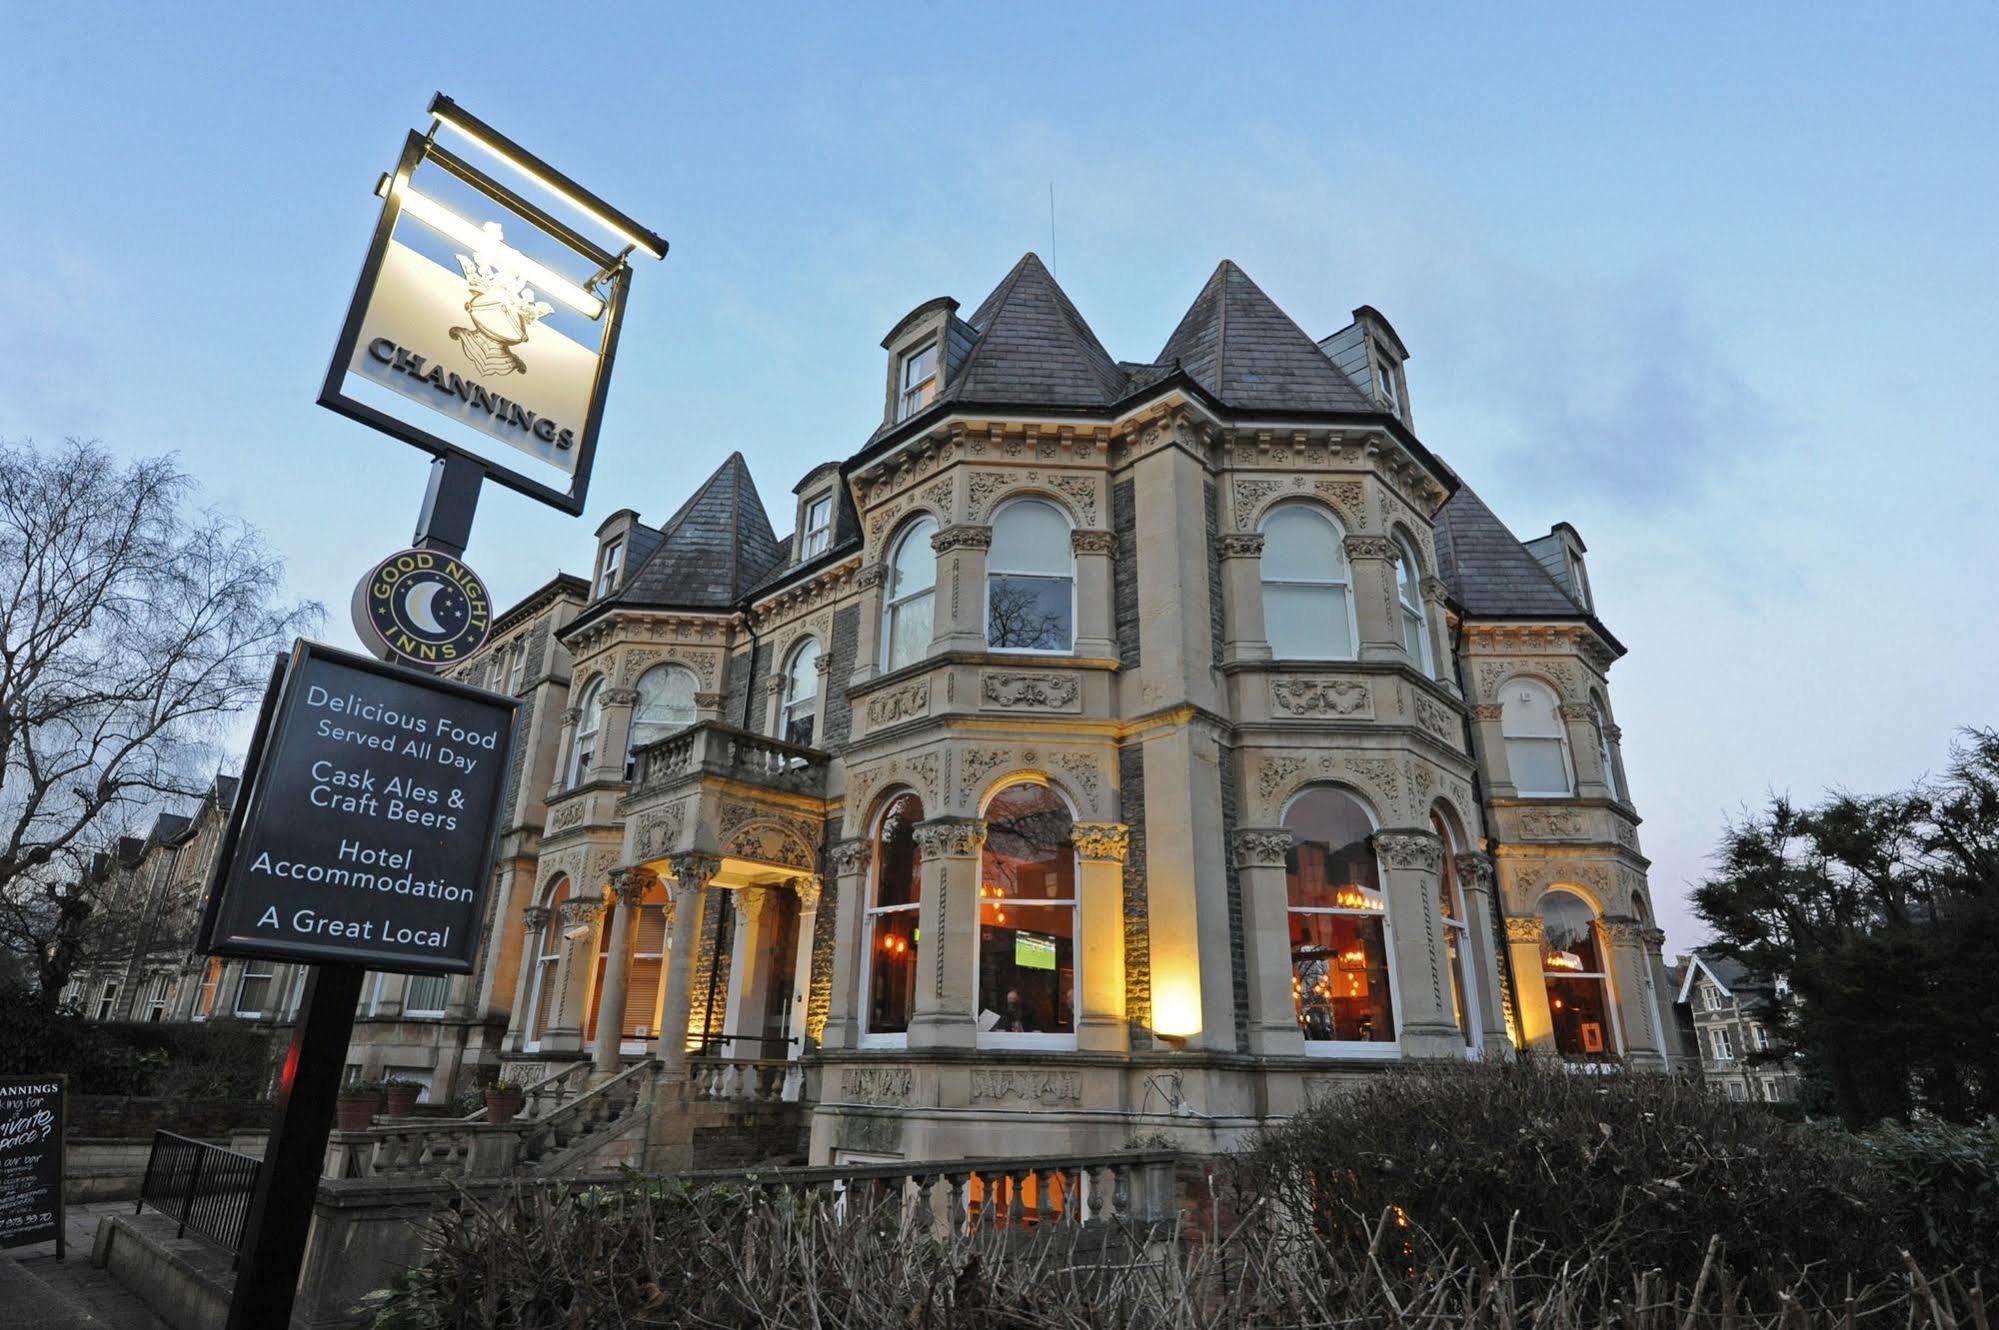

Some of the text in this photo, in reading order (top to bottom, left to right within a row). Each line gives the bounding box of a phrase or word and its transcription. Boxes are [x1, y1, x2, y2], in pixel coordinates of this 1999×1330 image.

[368, 336, 576, 450] CHANNINGS
[374, 553, 487, 632] GOOD NIGHT
[385, 625, 457, 660] INNS
[306, 685, 498, 750] Delicious Food
[316, 719, 478, 775] Served All Day
[310, 785, 457, 831] Craft Beers
[311, 760, 466, 810] Cask Ales &
[250, 851, 475, 903] Accommodation
[338, 838, 413, 871] Hotel
[256, 905, 450, 948] A Great Local
[0, 1084, 59, 1096] ANNINGS
[0, 1096, 45, 1112] king for
[0, 1109, 55, 1137] rivate
